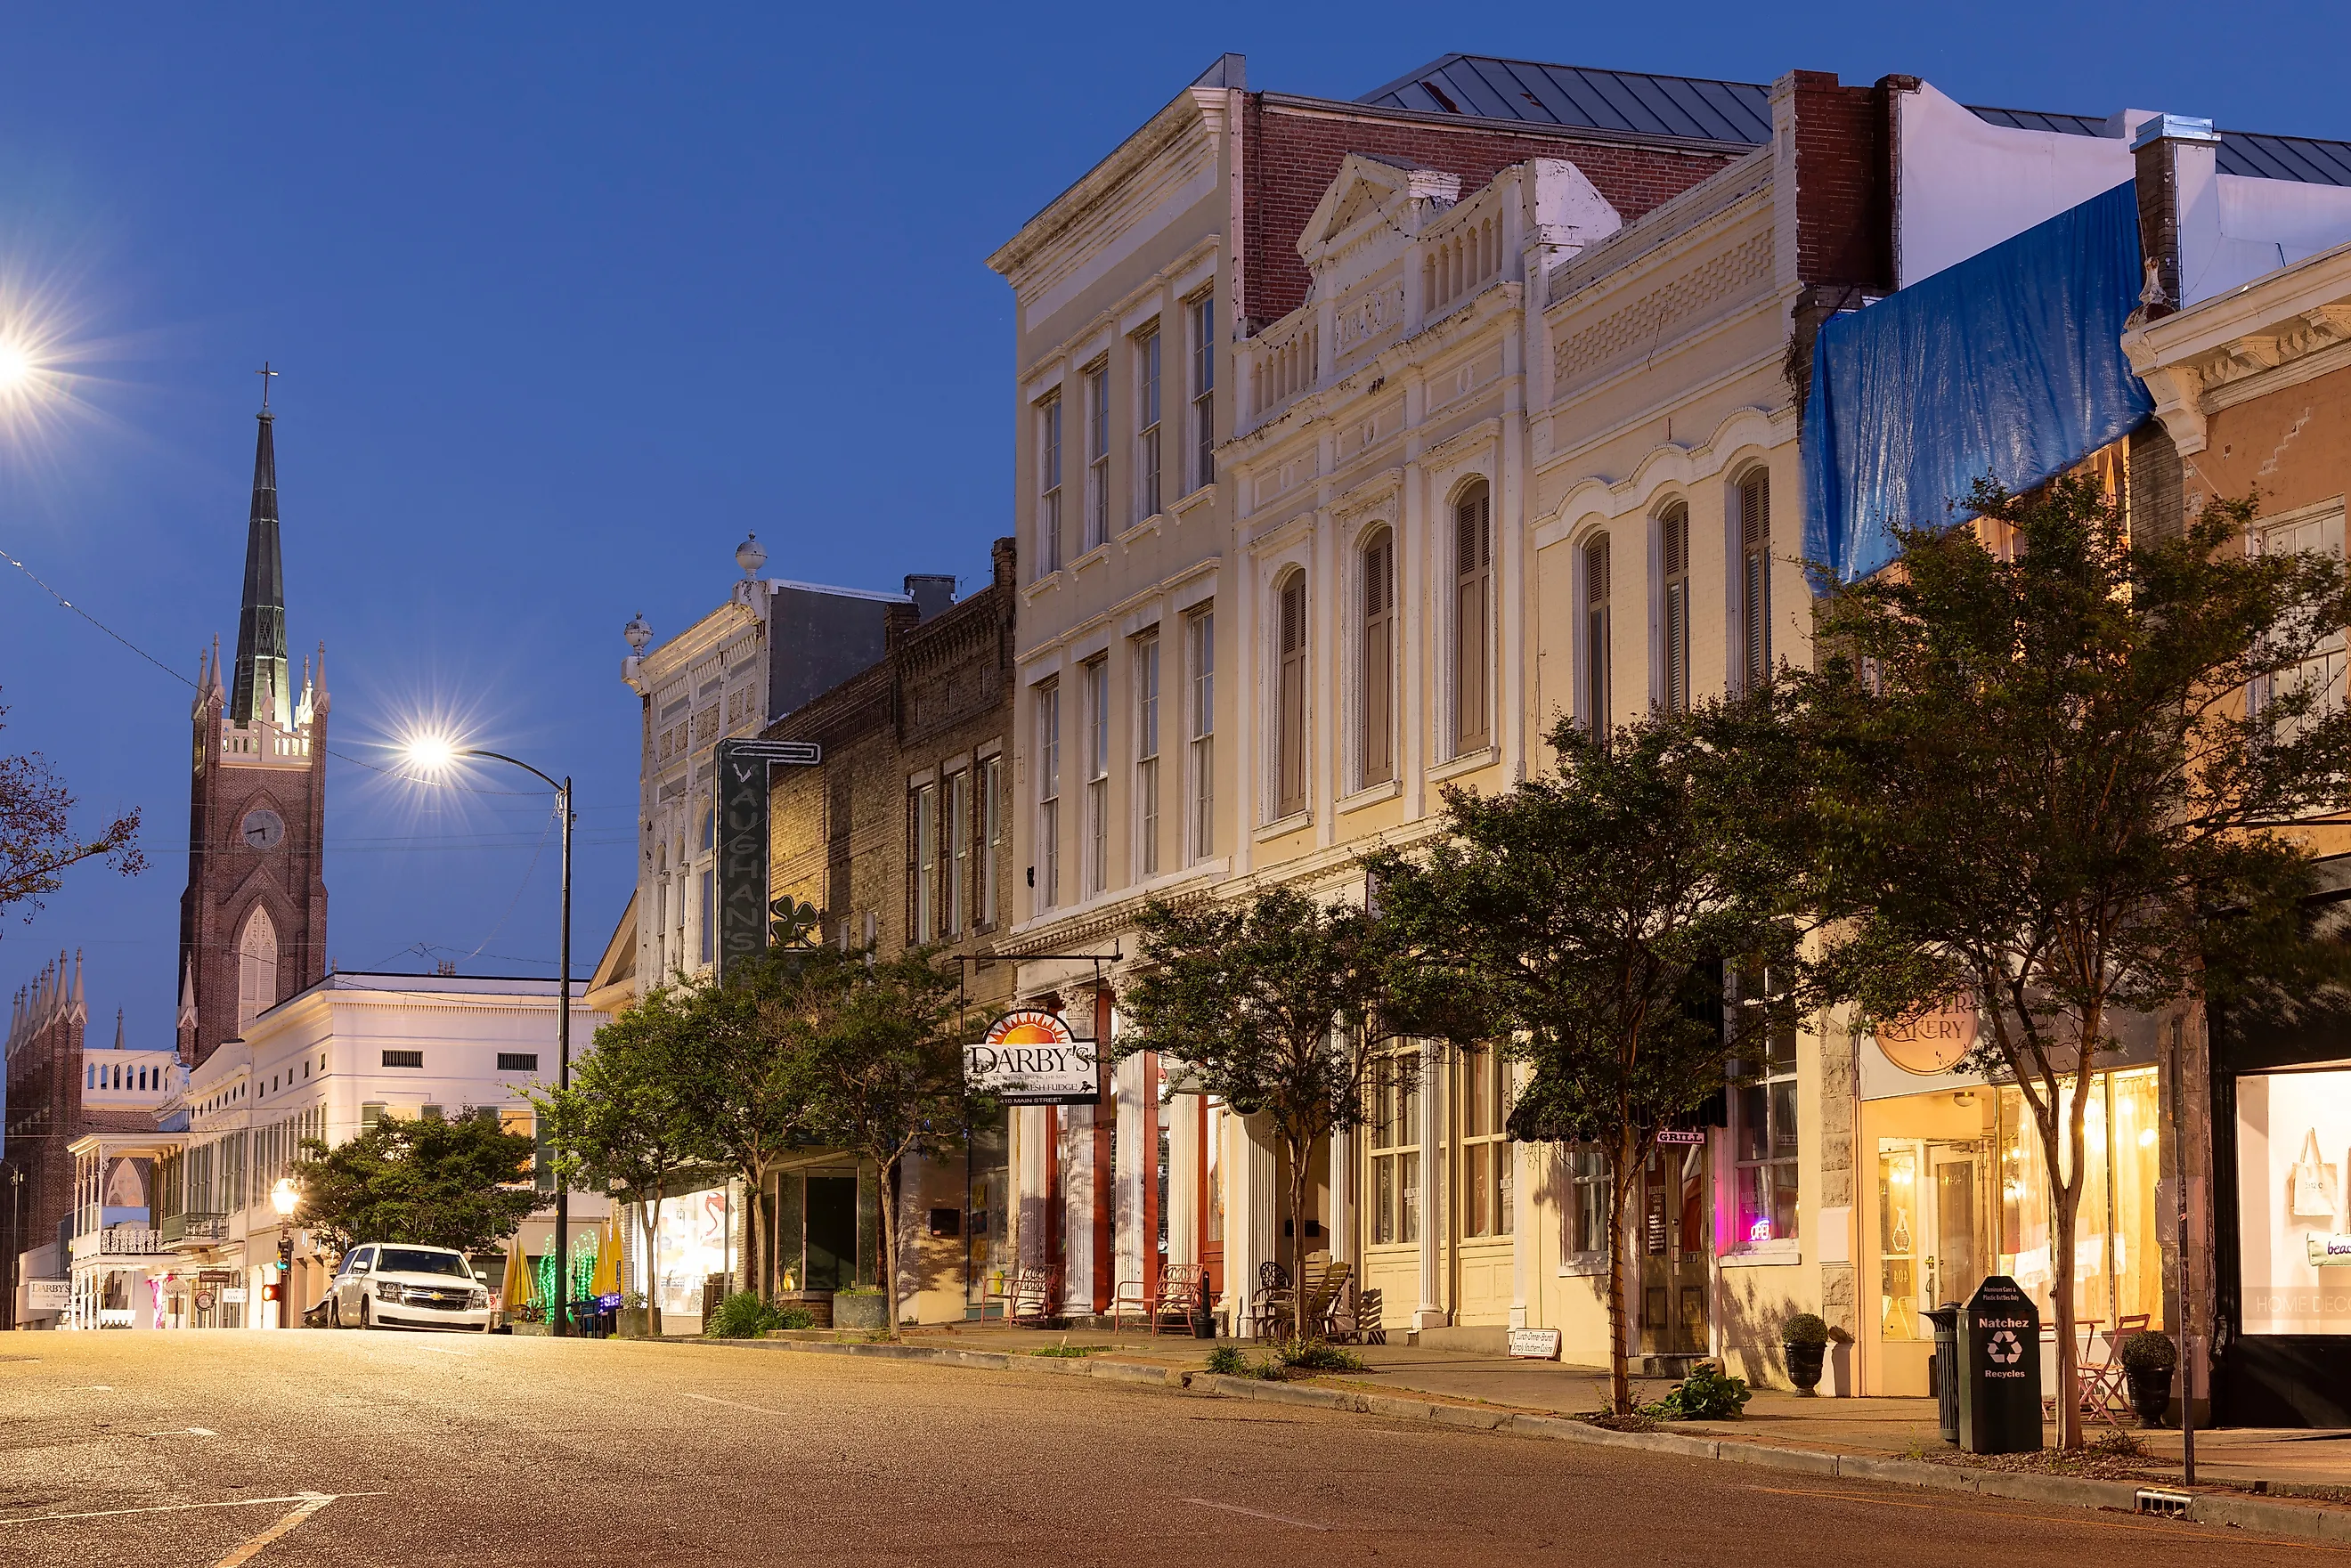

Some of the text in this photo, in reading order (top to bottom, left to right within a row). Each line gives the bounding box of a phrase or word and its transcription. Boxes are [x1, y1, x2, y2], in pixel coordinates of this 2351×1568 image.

[724, 762, 759, 951] VAUGHAN'S
[1888, 1020, 1965, 1042] AKERY
[971, 1045, 1091, 1074] DARBY'S
[1047, 1083, 1078, 1092] FUDGE!
[1659, 1133, 1703, 1142] GRILL
[32, 1282, 70, 1293] DARBY'S
[2256, 1296, 2351, 1312] HOME DEC
[1979, 1318, 2029, 1328] Natchez
[1984, 1370, 2025, 1379] Recycles
